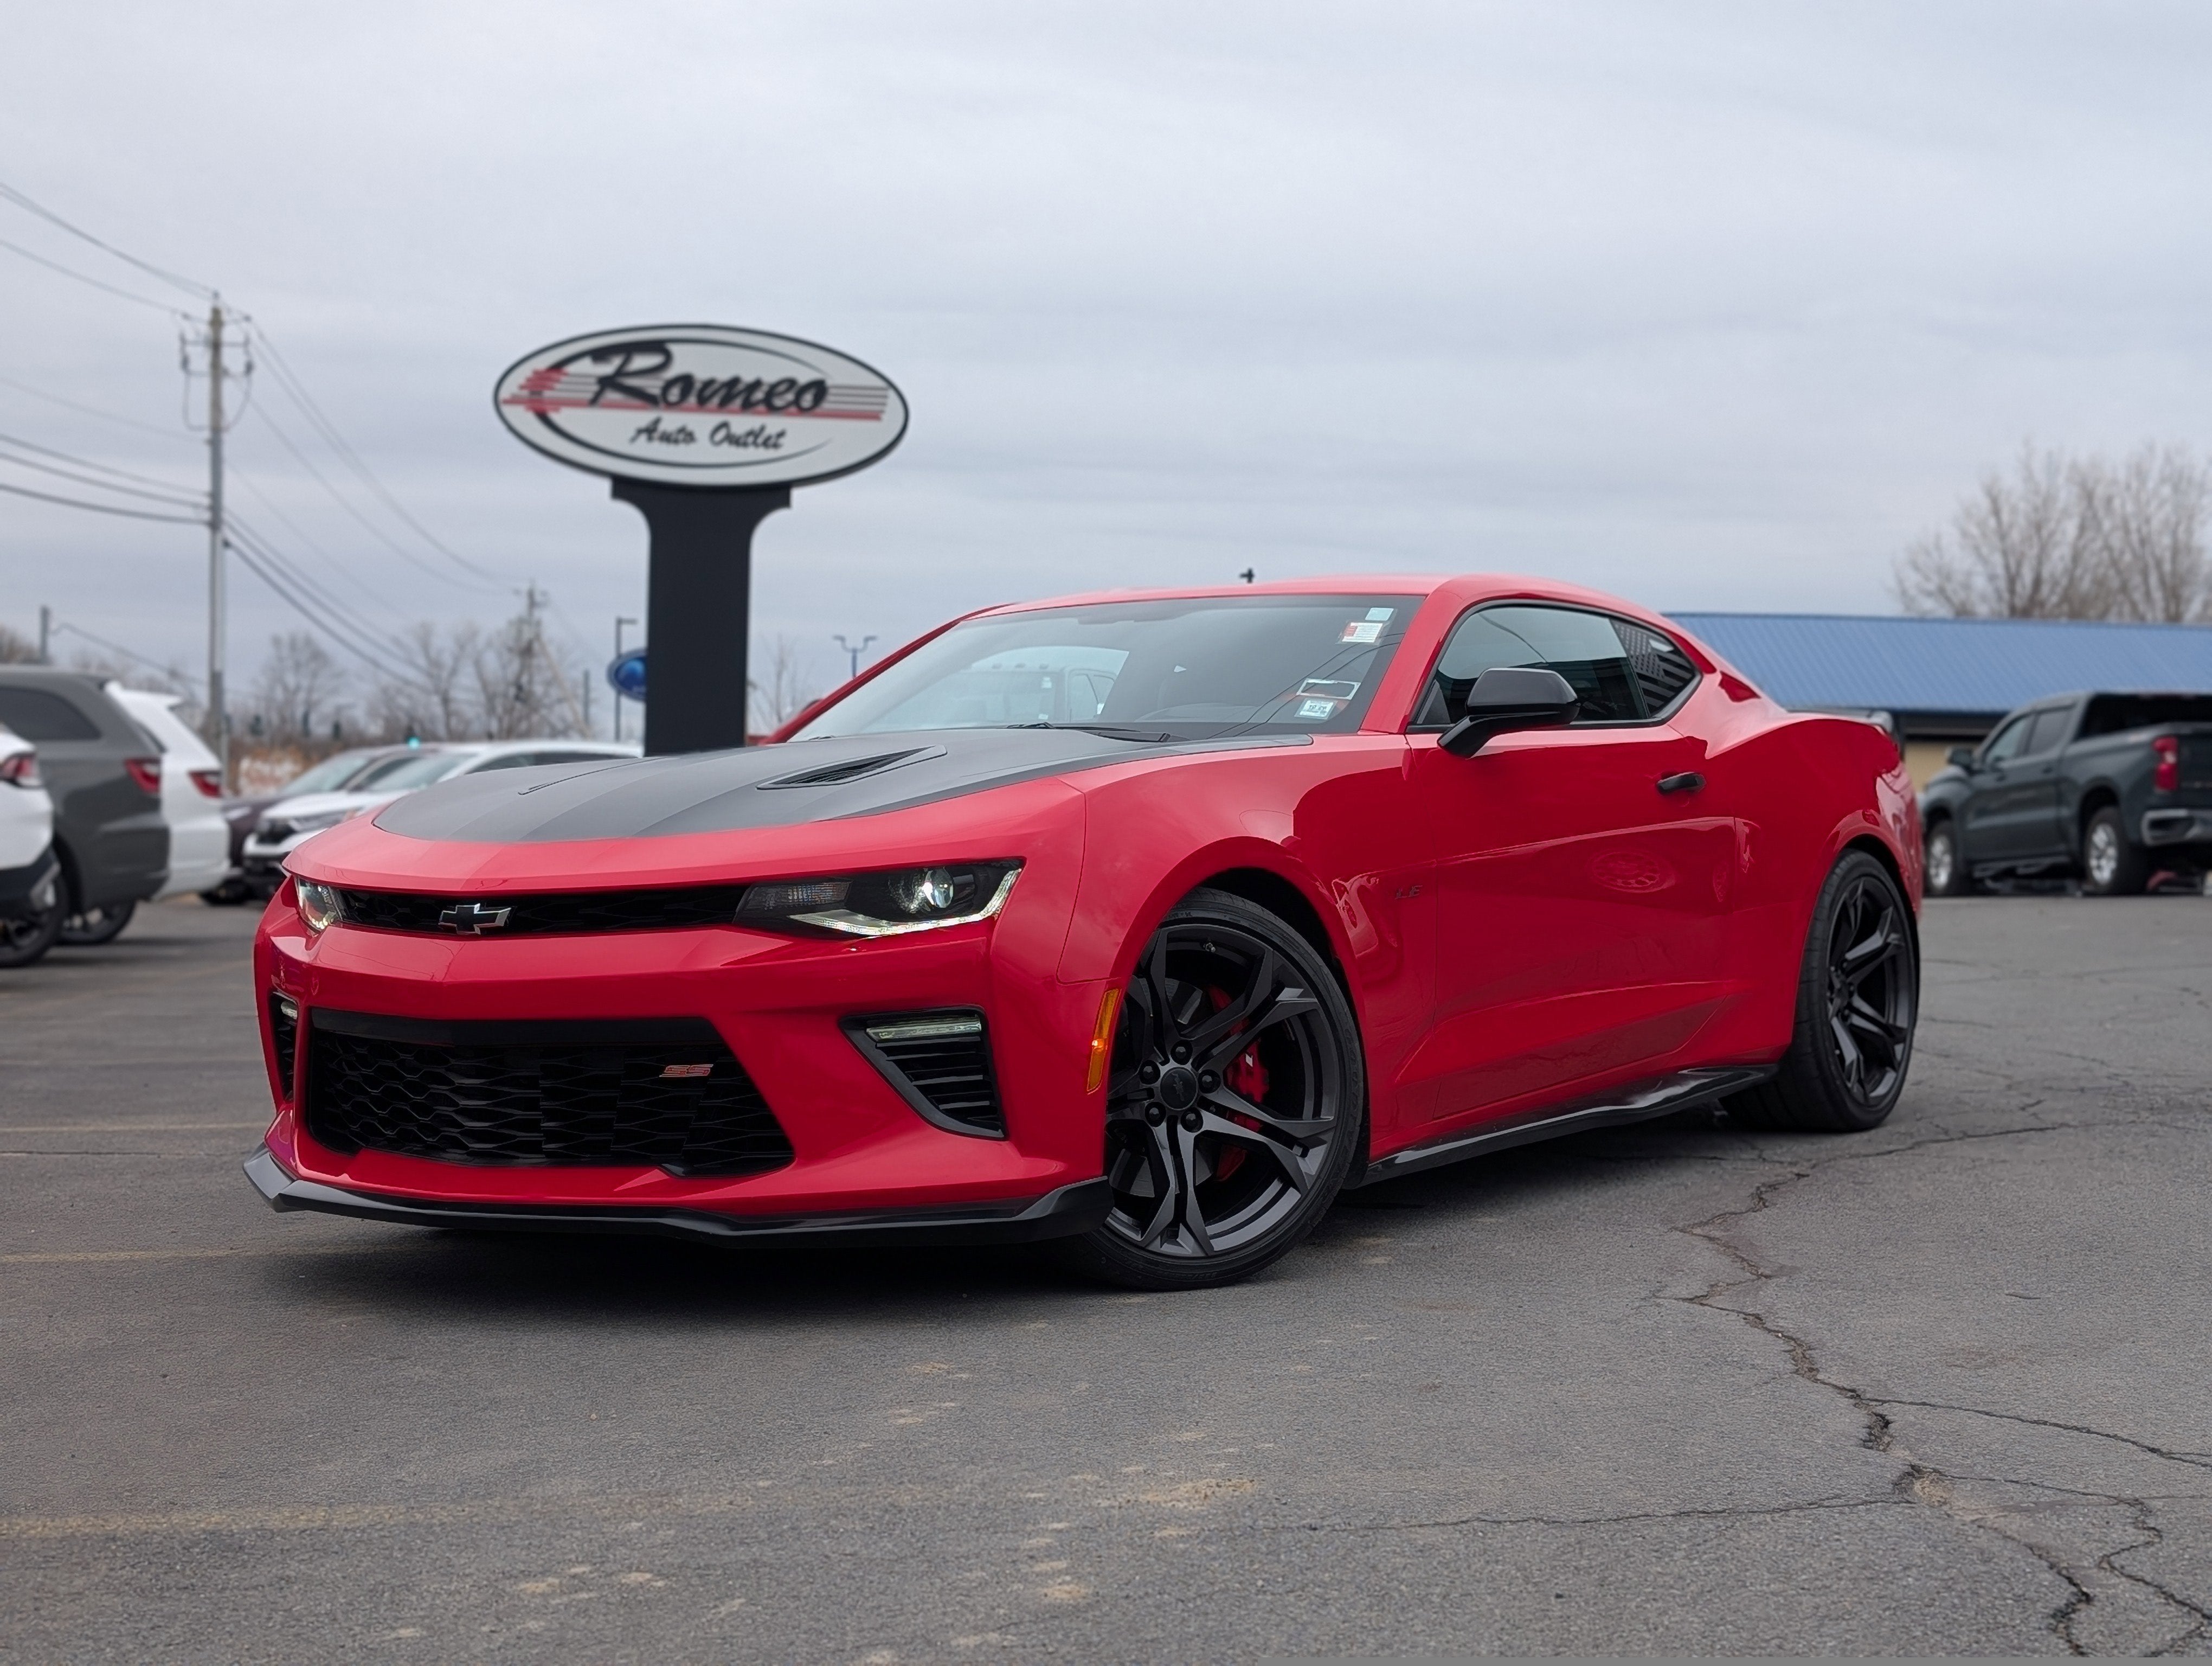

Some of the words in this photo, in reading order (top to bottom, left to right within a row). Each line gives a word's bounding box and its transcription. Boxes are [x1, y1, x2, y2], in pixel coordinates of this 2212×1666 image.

[589, 340, 828, 413] Romeo
[629, 416, 696, 445] Auto
[709, 420, 787, 450] Outlet
[659, 1063, 714, 1078] SS
